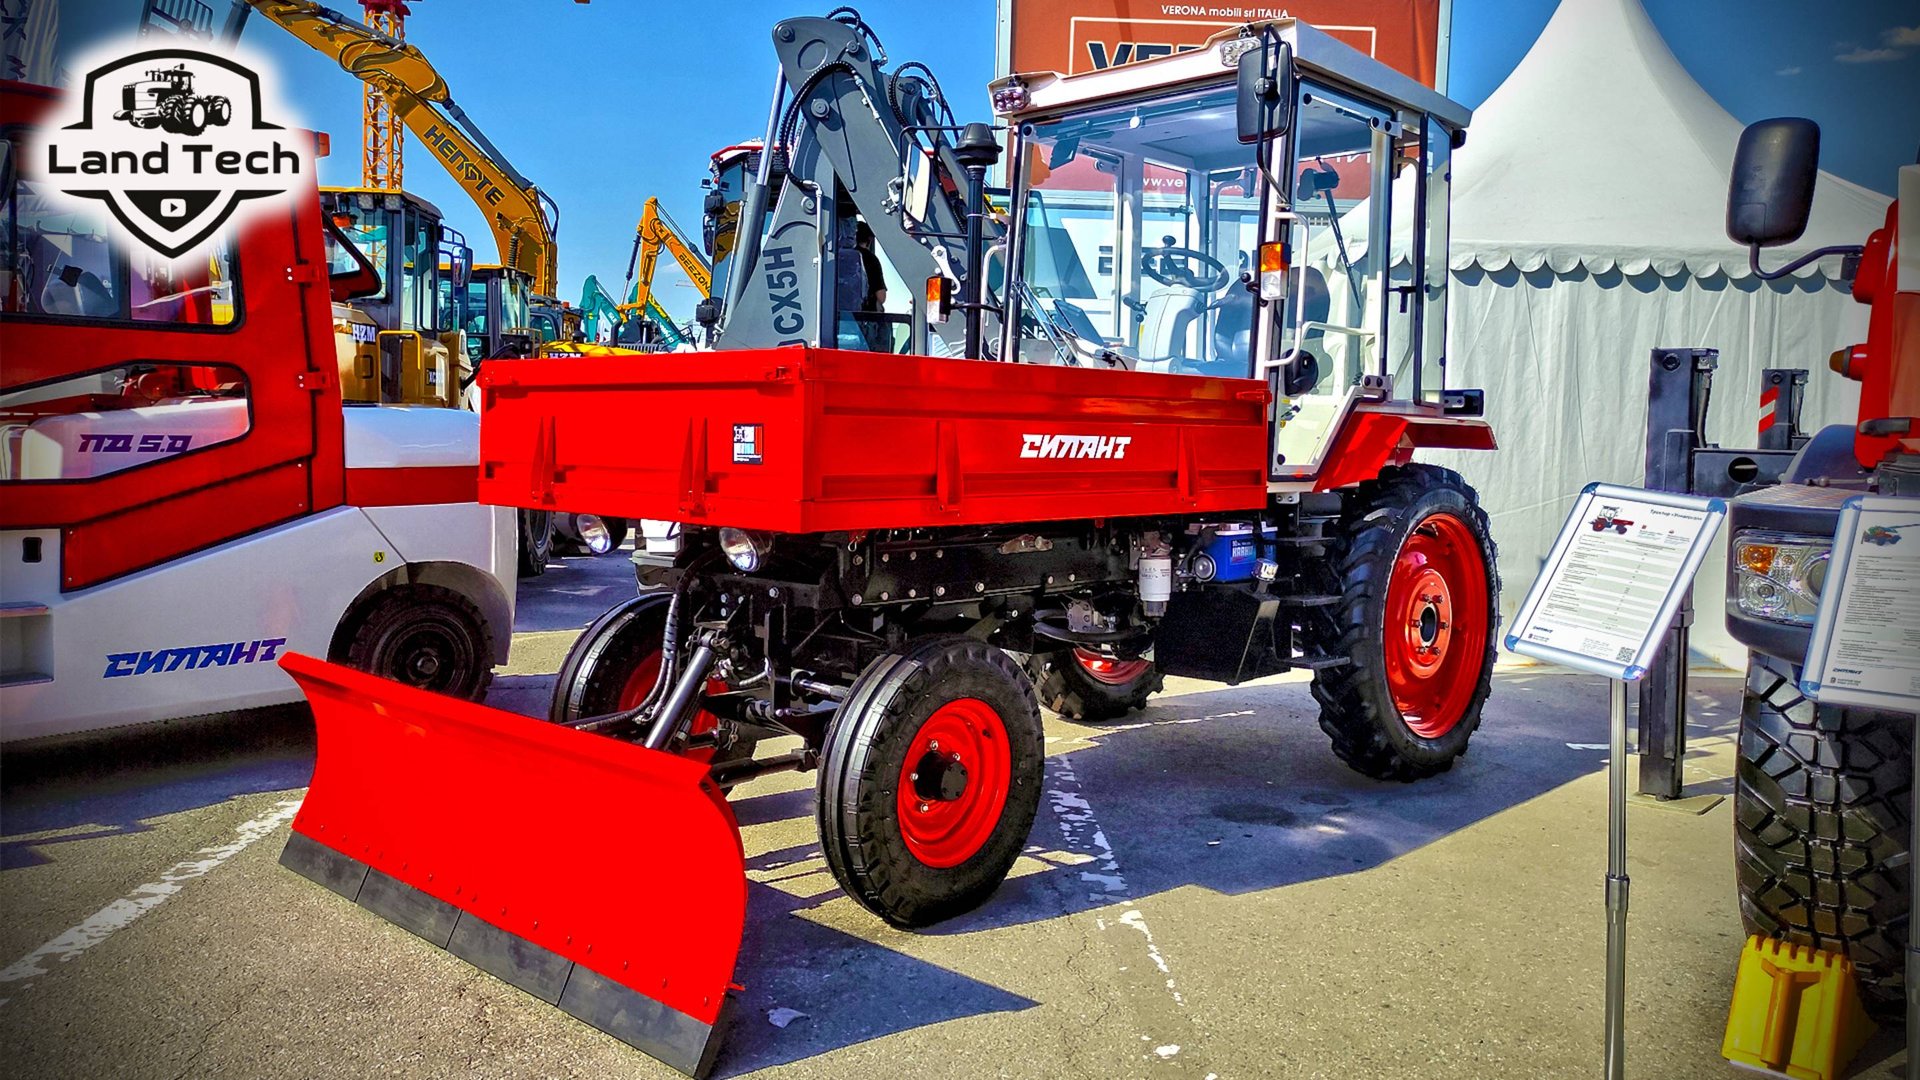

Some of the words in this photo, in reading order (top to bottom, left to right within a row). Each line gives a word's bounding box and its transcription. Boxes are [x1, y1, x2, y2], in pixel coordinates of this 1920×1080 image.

[1161, 5, 1206, 16] VERONA
[1209, 7, 1242, 17] mobili
[1243, 8, 1256, 18] srl
[1257, 9, 1289, 19] ITALIA
[352, 323, 376, 343] HZM
[1020, 433, 1132, 459] СИЛАНТ
[103, 637, 287, 679] СИЛАНТ
